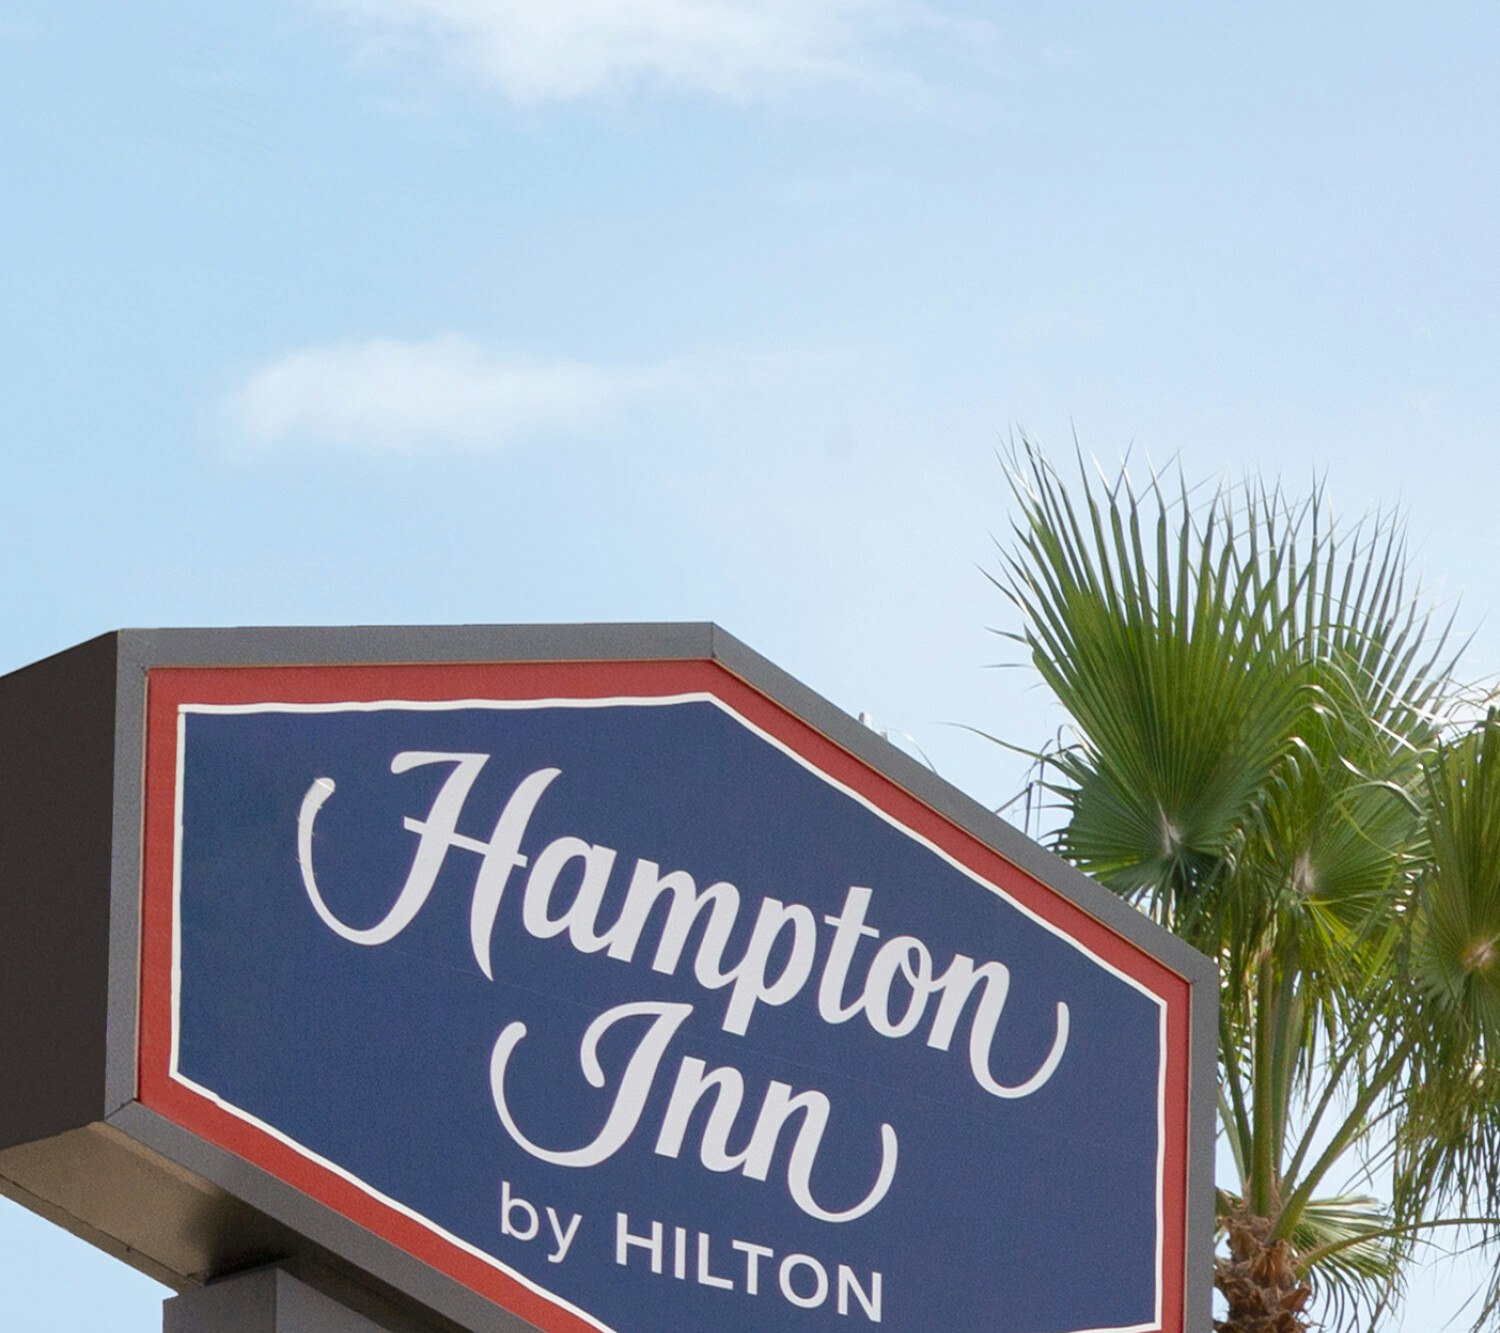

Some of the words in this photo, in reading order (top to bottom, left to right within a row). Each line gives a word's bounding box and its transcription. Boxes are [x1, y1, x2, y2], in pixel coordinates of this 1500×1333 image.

[297, 750, 1069, 1100] Hampton
[490, 1001, 899, 1223] Inn
[500, 1181, 582, 1264] by
[614, 1214, 884, 1324] HILTON
